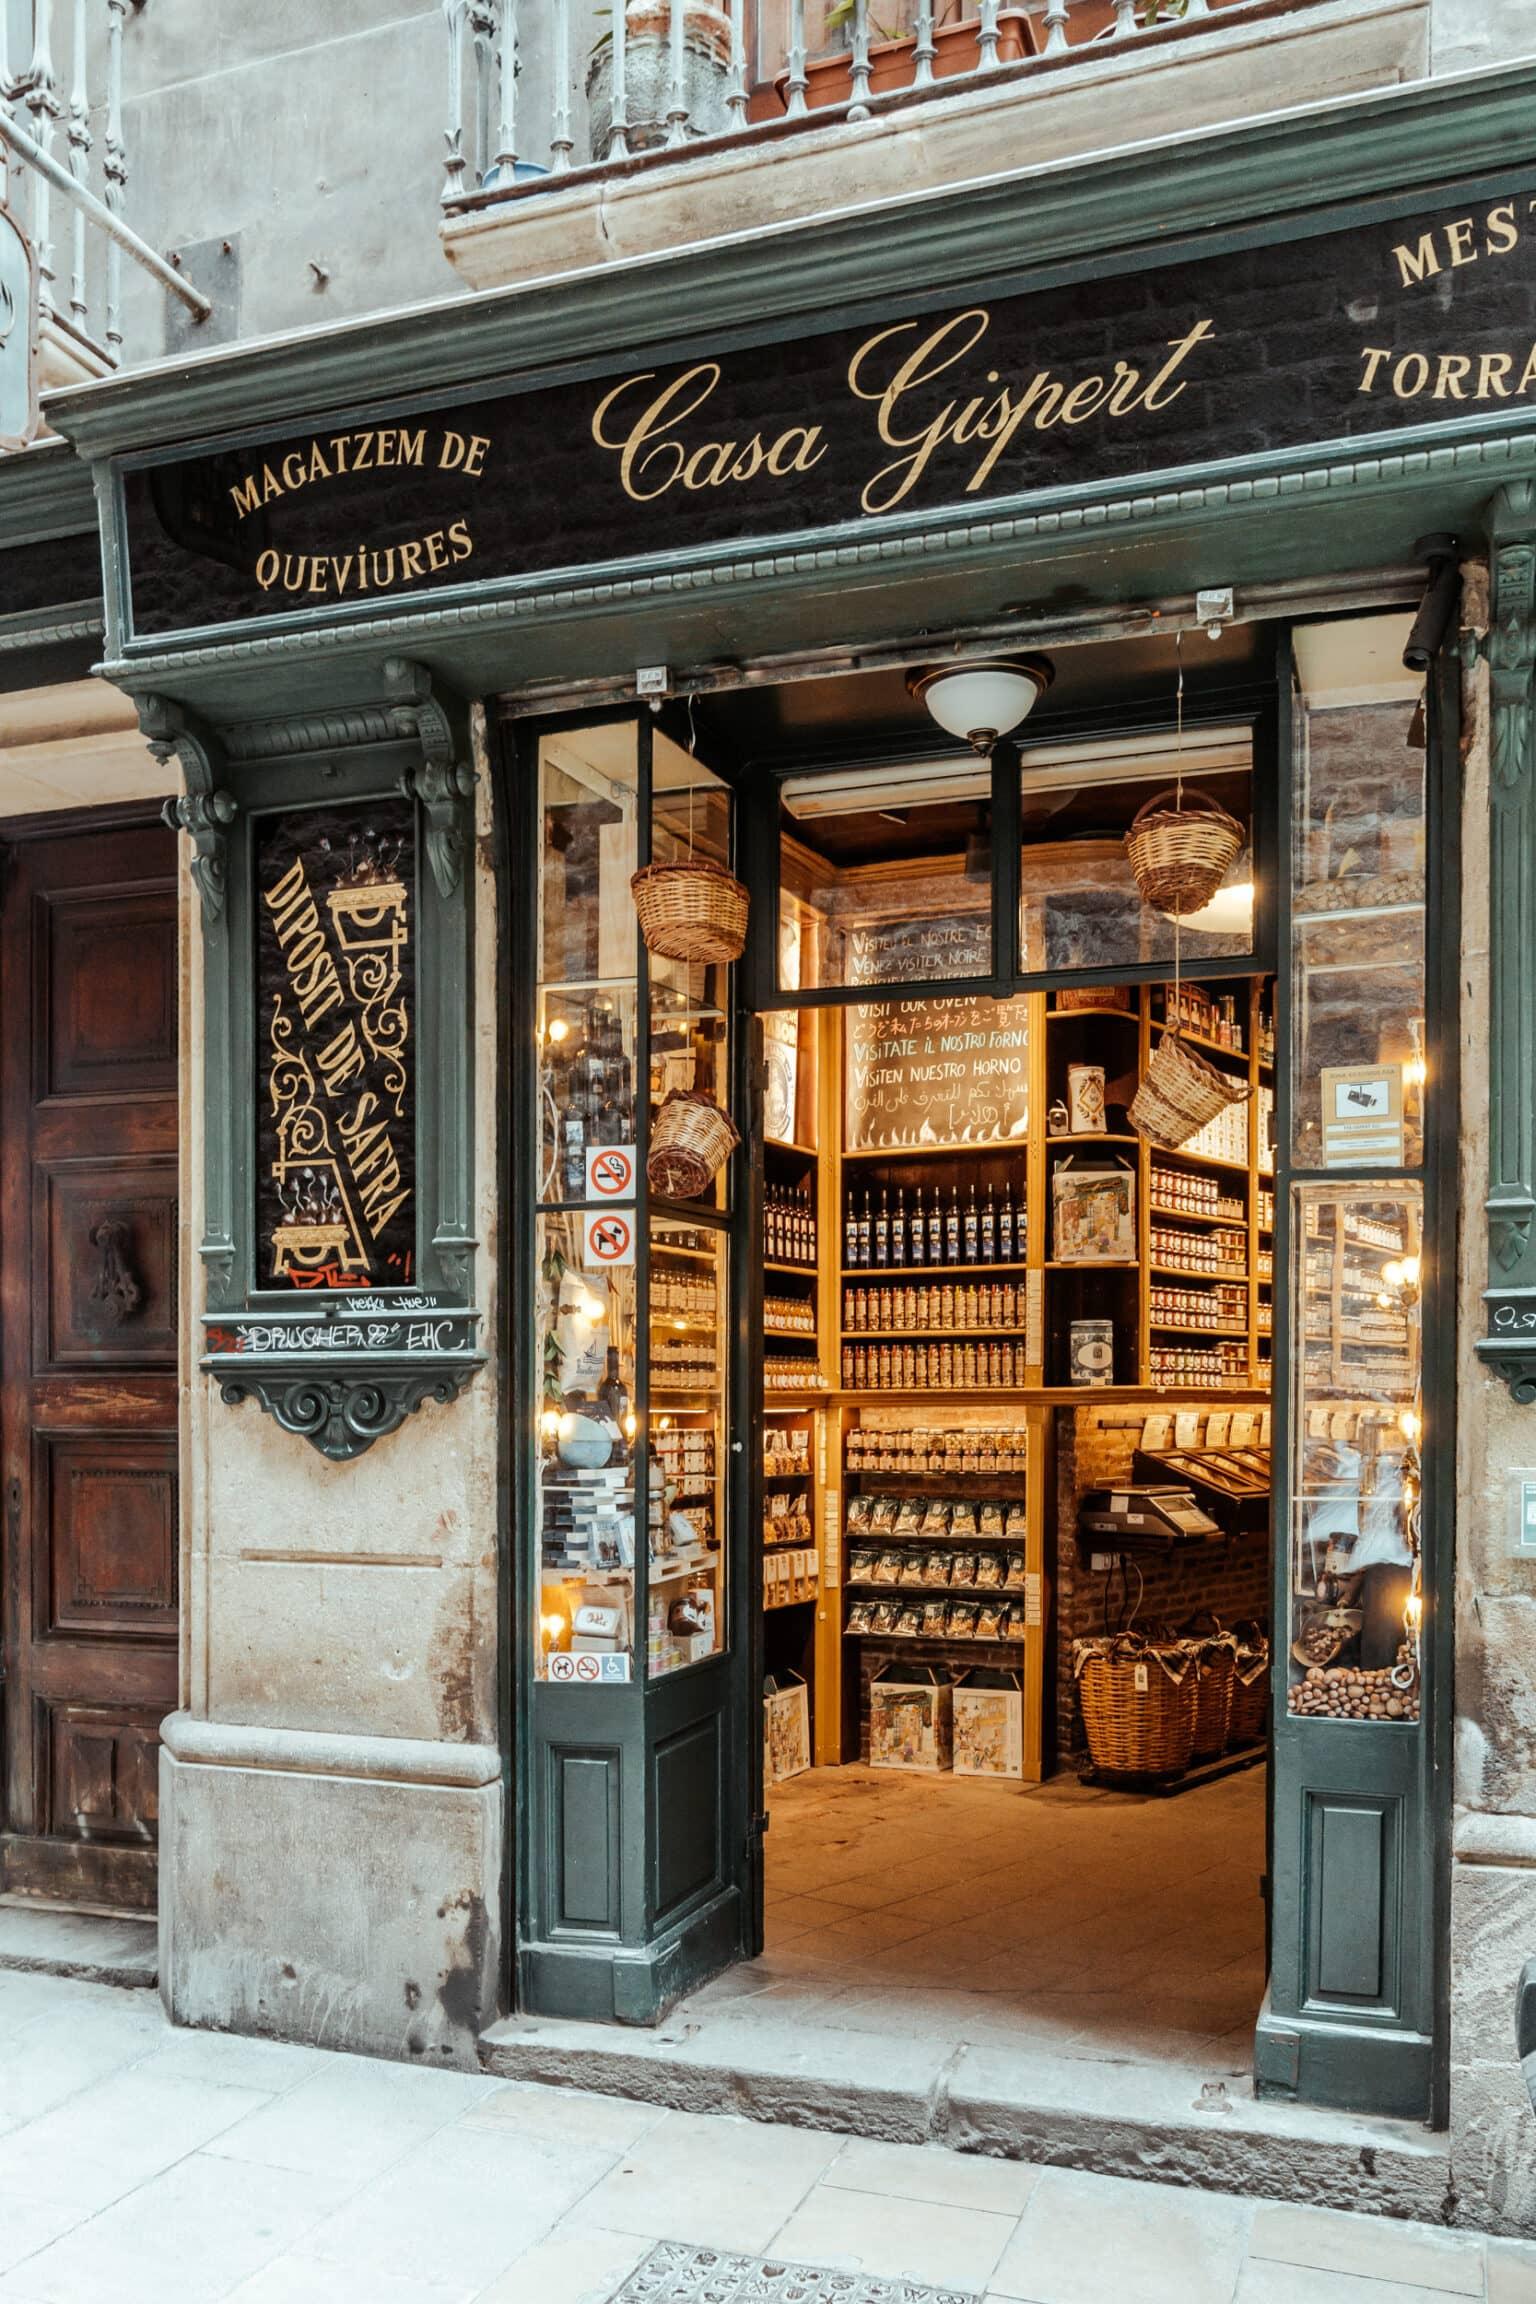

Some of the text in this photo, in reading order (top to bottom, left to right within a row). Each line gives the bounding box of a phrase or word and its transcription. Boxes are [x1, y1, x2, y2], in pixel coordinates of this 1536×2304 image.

[591, 309, 1215, 514] Casa Gispert
[229, 429, 491, 520] MAGATZEM DE
[897, 953, 944, 972] VISITER
[948, 946, 987, 965] NOTRE
[264, 855, 412, 1240] DIPOSIT DE SAFRA
[909, 1062, 966, 1082] NUESTRO
[973, 1057, 1021, 1076] HORNO
[941, 1032, 985, 1052] NOSTRO
